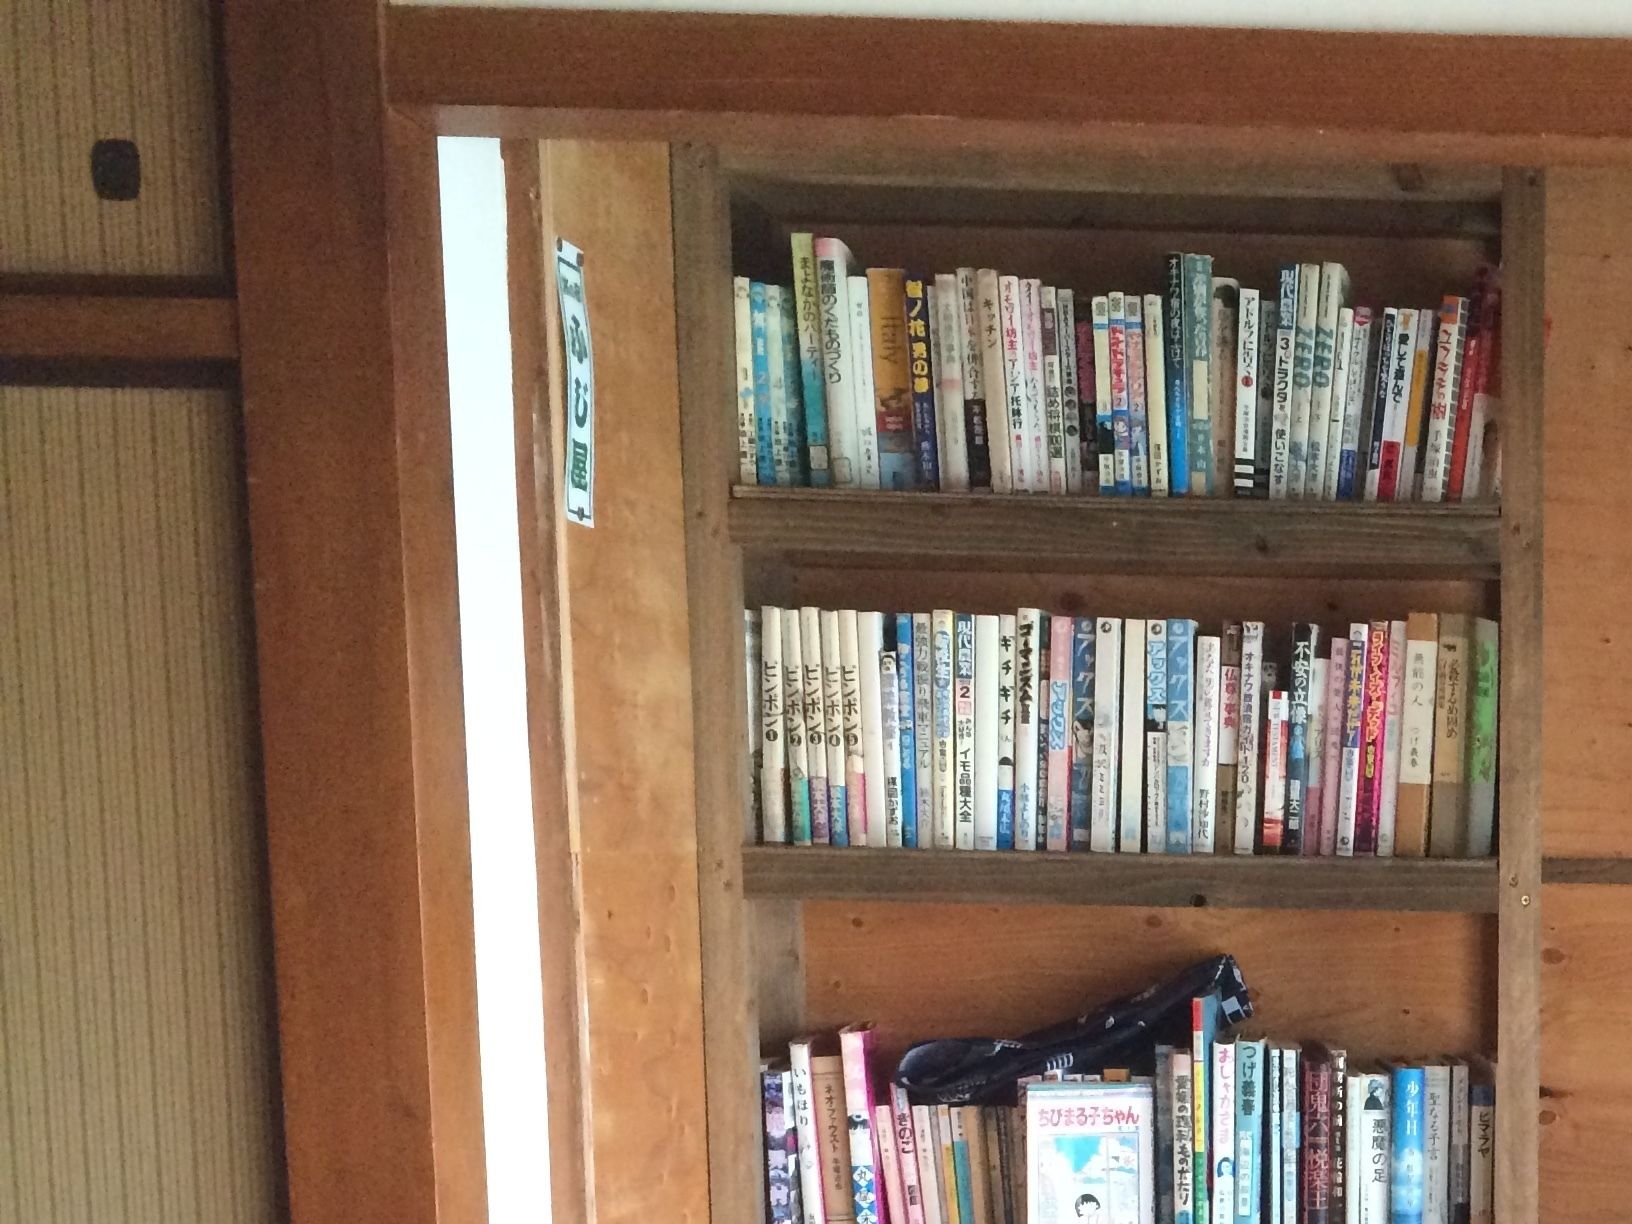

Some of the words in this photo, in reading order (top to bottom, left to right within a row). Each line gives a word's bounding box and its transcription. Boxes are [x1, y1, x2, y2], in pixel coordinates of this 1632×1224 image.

[983, 299, 998, 349] キッチン
[763, 660, 779, 728] ピンポン
[785, 665, 802, 734] ピンポン
[804, 663, 822, 732] ピンポン
[825, 665, 841, 734] ピンポン
[842, 664, 859, 734] ピンポン
[959, 686, 971, 699] 2
[1075, 632, 1096, 717] アックス
[1149, 641, 1167, 703] アックス
[1169, 634, 1189, 722] アックス
[1292, 641, 1312, 723] 不安の立像
[1411, 652, 1427, 708] 無能の人
[958, 749, 973, 824] イモ品種大全
[1242, 1045, 1258, 1117] つげ義春
[1038, 1105, 1140, 1127] ちびまる子ちゃん
[1371, 1117, 1389, 1183] 悪魔の足
